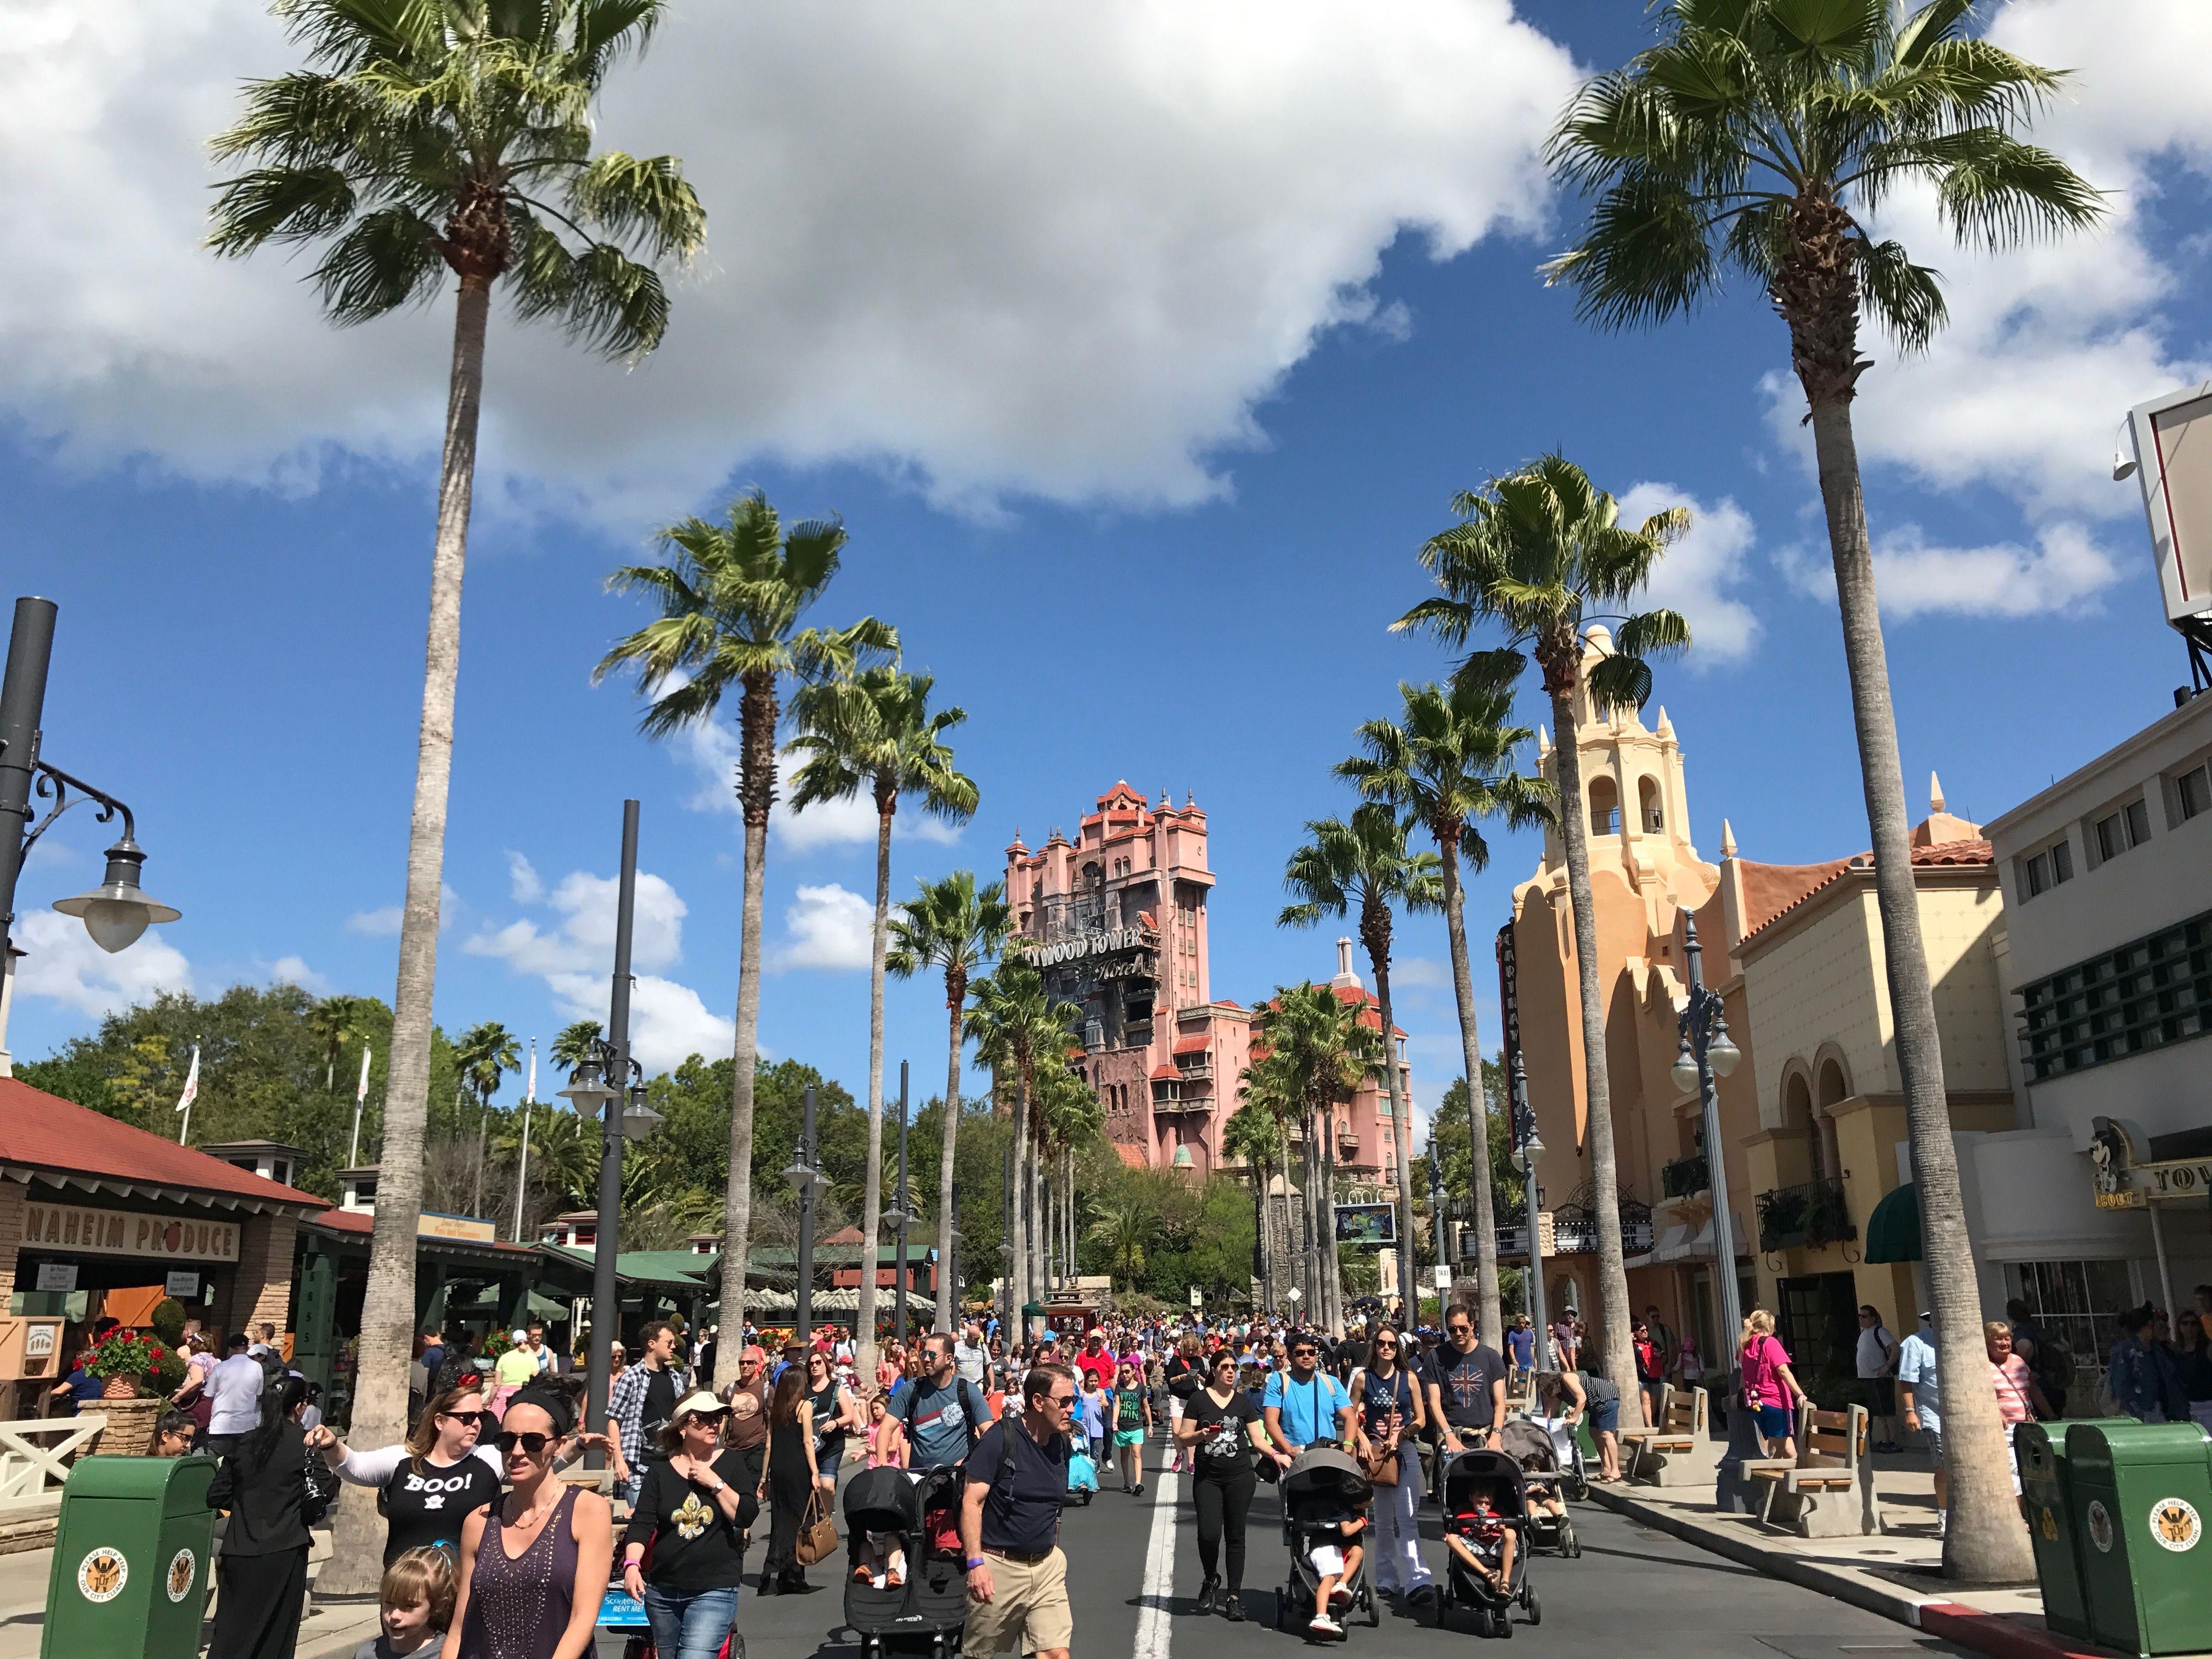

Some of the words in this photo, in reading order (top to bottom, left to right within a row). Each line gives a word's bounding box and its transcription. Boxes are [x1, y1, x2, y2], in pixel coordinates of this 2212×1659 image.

[1024, 939, 1088, 967] YWOOD
[1092, 928, 1140, 955] TOWER
[26, 1207, 125, 1248] NAHEIM
[1583, 1237, 1591, 1246] A
[1120, 1391, 1140, 1401] WRK
[1120, 1401, 1139, 1410] HRD
[1120, 1409, 1138, 1421] WIN
[404, 1473, 472, 1492] BOO!
[2152, 1503, 2165, 1523] PLEASE
[2186, 1506, 2198, 1521] KEEP
[2155, 1531, 2168, 1545] OUR
[2186, 1529, 2199, 1547] CLEAN
[81, 1551, 100, 1571] PLEASE
[117, 1557, 126, 1573] KEEP
[80, 1579, 90, 1594] OUR
[106, 1581, 123, 1599] CLEAN
